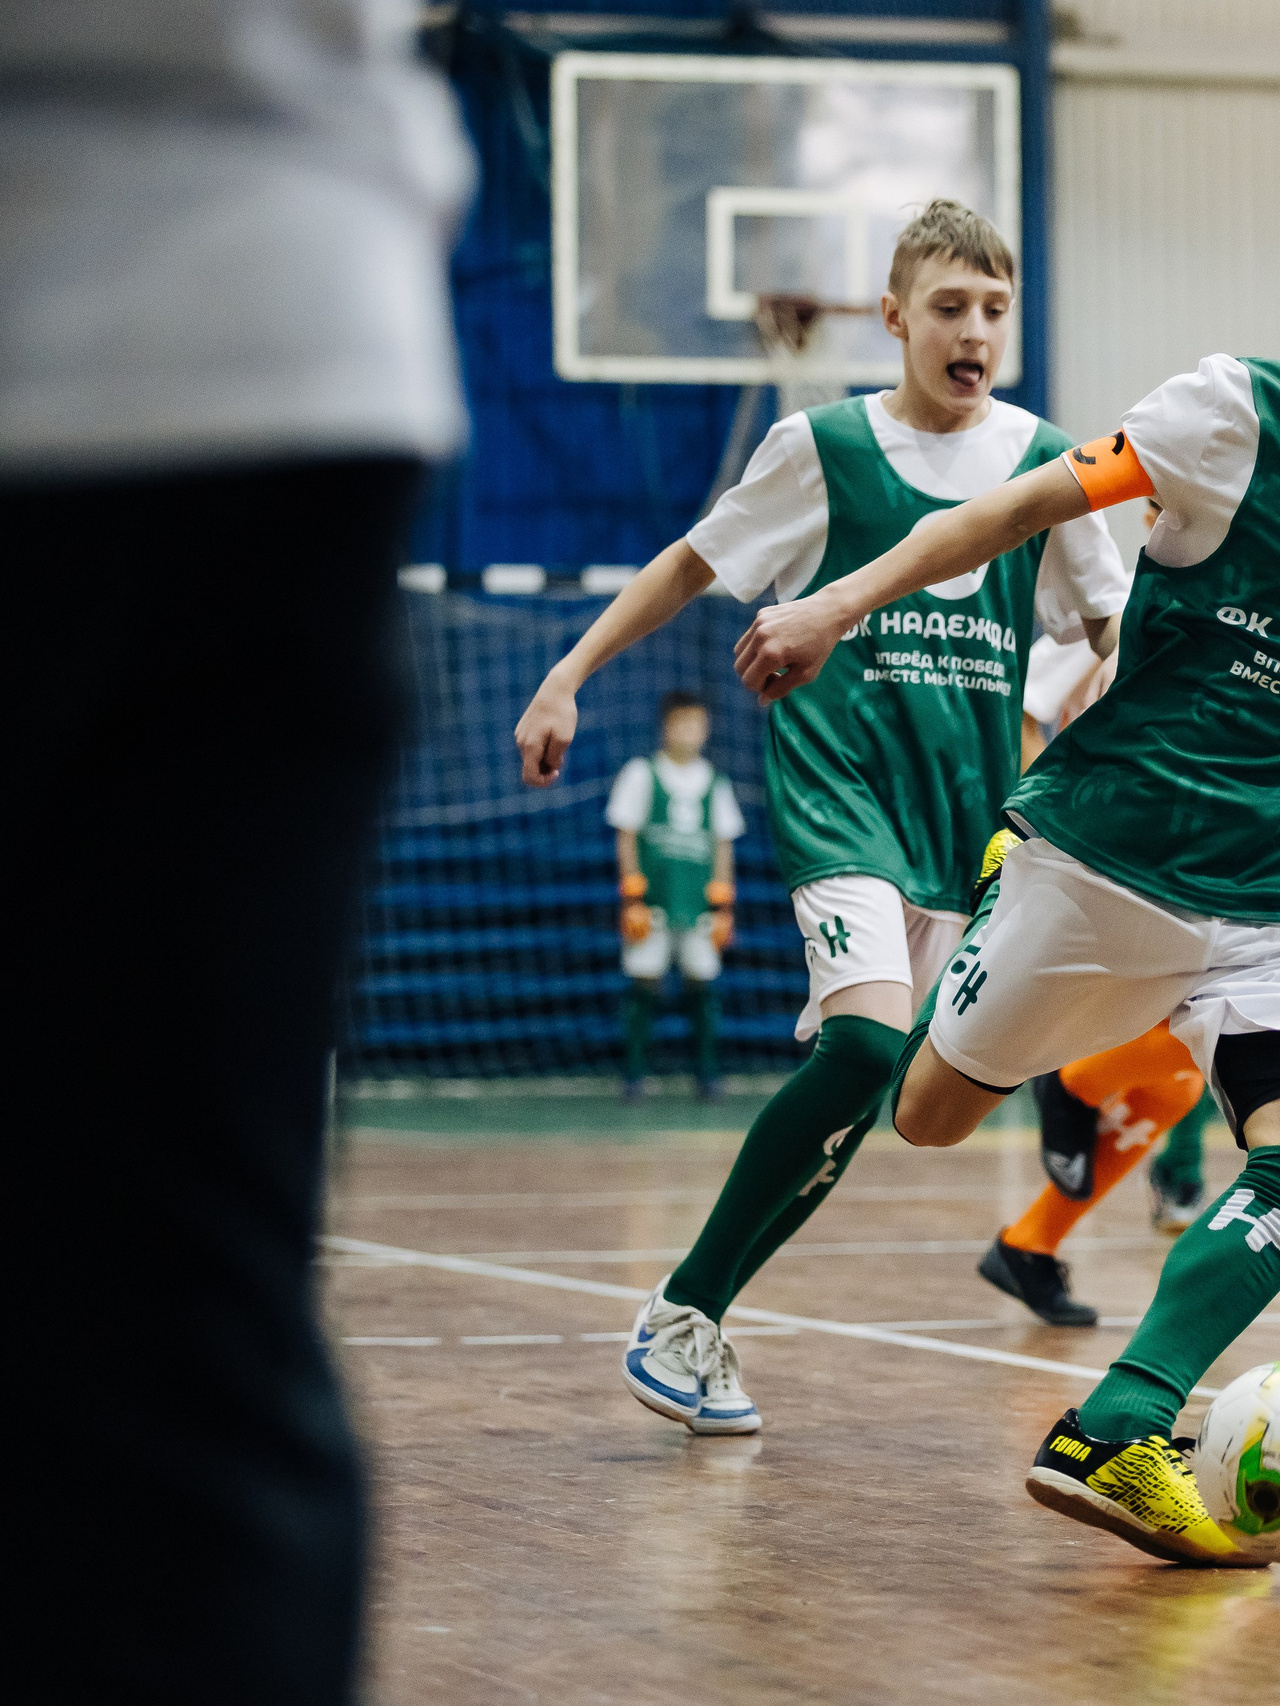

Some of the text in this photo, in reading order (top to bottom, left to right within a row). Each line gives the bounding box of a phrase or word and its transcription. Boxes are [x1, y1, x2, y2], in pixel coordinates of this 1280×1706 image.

[1216, 606, 1271, 639] ФК
[937, 655, 951, 669] К
[923, 671, 953, 686] МЫ
[1049, 1434, 1093, 1463] FURIA
